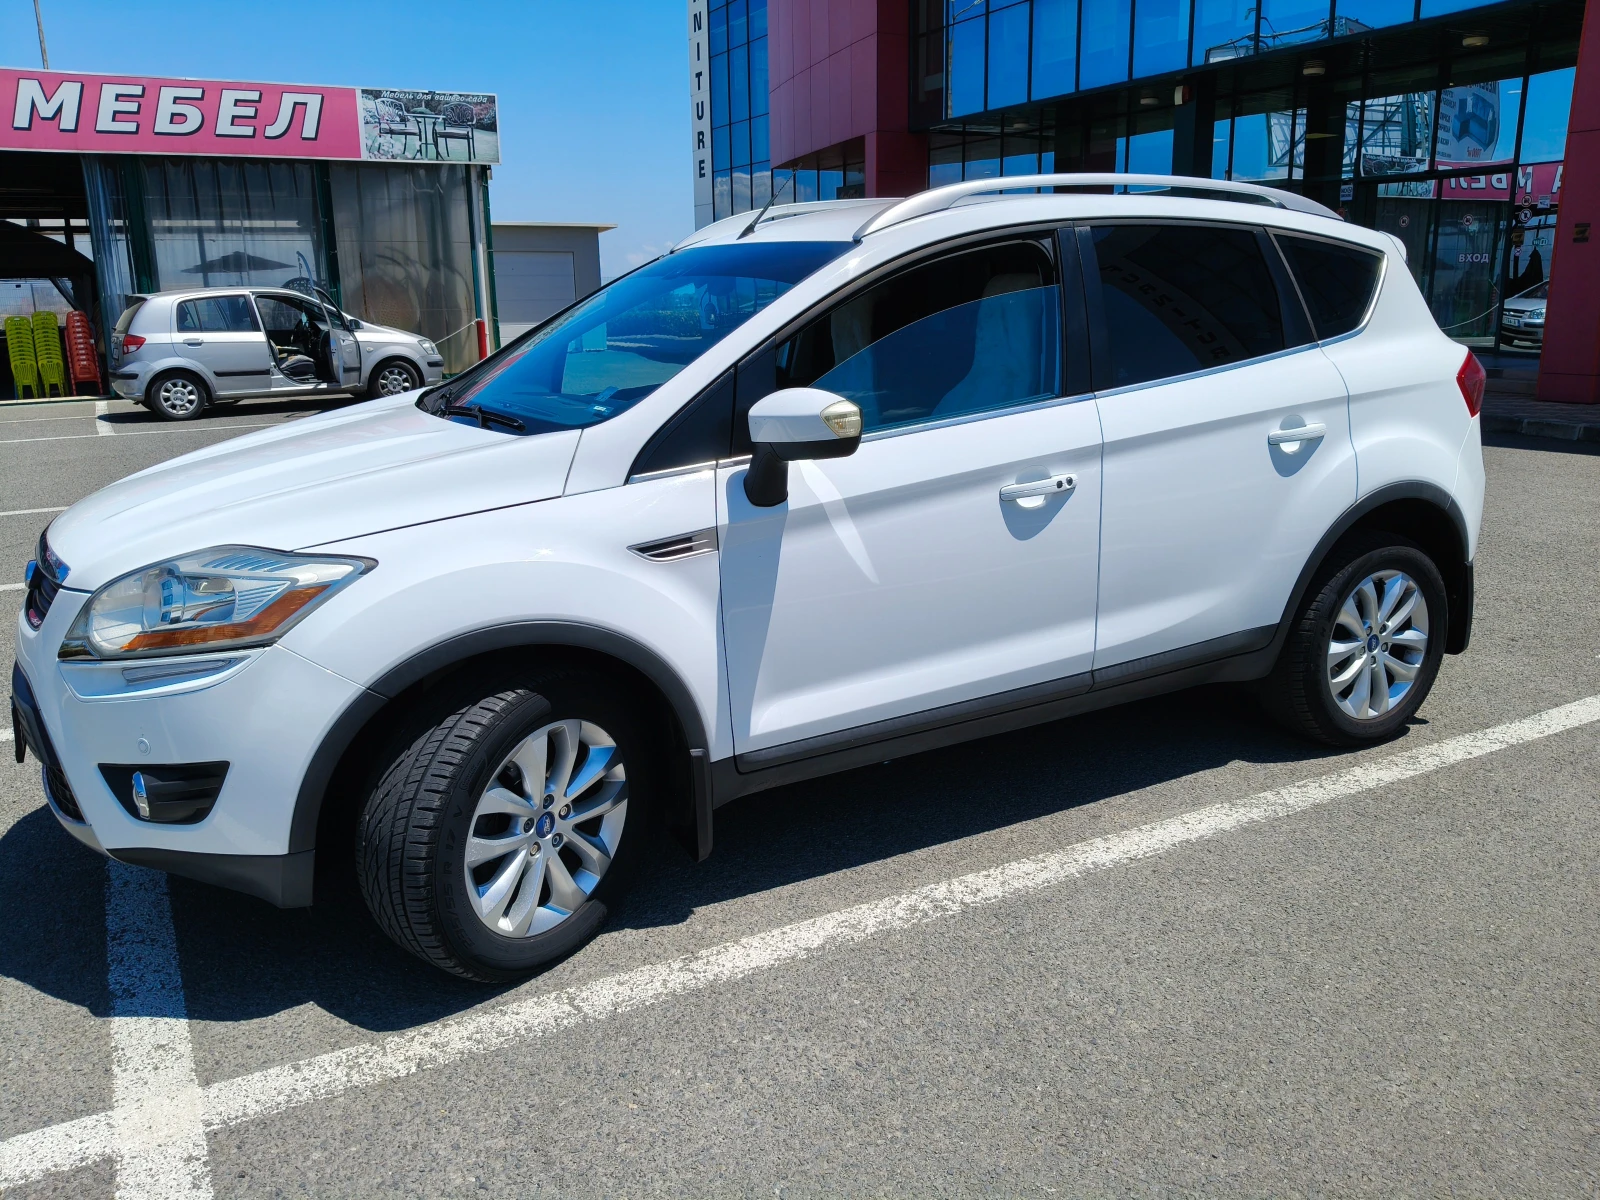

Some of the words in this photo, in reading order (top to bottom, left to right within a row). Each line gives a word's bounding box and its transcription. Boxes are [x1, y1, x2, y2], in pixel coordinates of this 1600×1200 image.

[381, 90, 414, 100] Мебель
[416, 93, 432, 101] для
[12, 77, 325, 141] МЕБЕЛ
[1458, 253, 1490, 264] ВХОД
